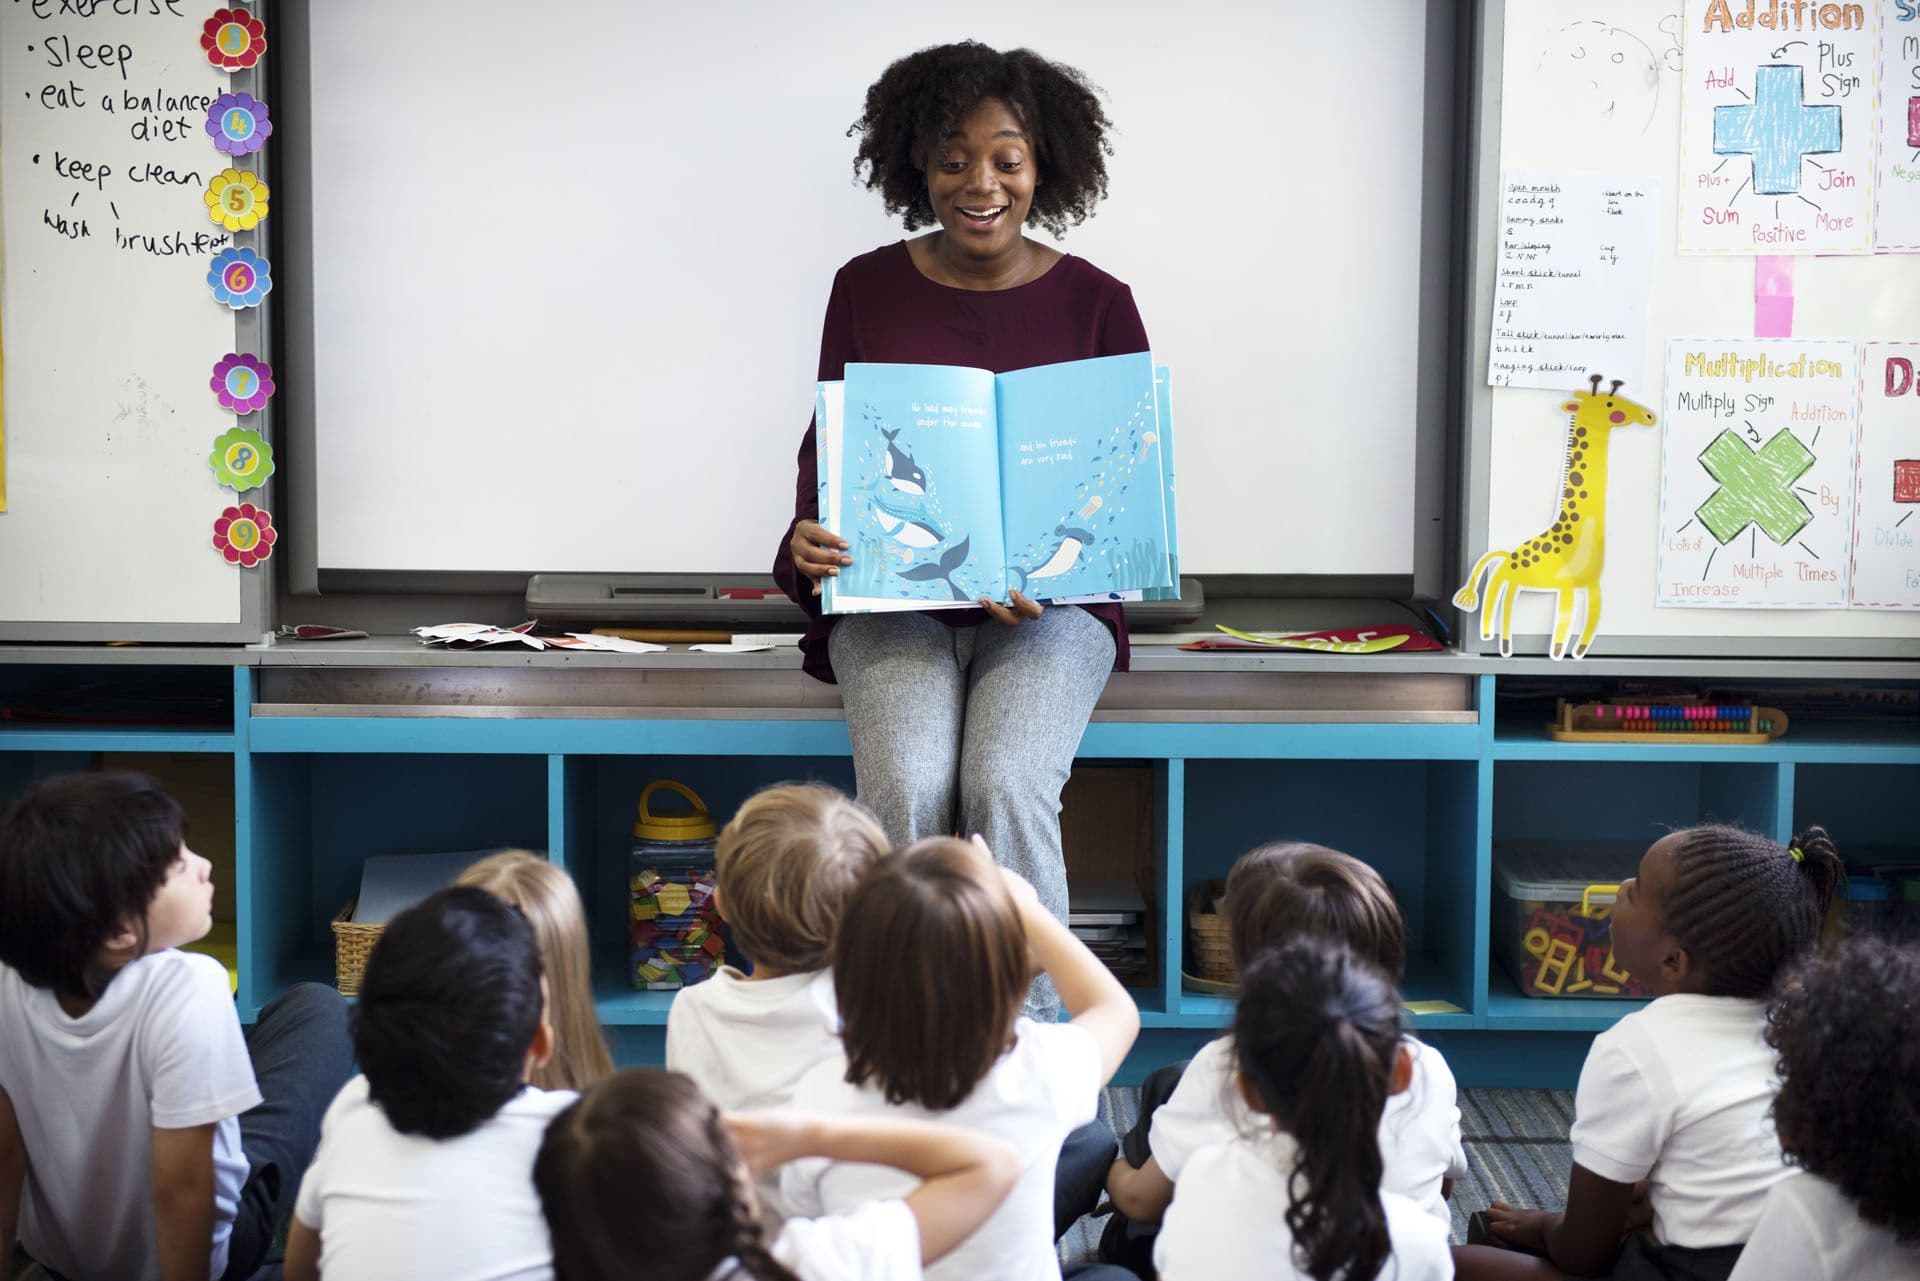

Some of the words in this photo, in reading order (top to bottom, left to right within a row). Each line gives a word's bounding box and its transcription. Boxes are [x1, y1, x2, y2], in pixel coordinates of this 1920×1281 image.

[1703, 0, 1864, 33] Addition
[224, 27, 241, 51] 3
[1818, 40, 1855, 73] Plus
[1704, 67, 1734, 90] Add
[1822, 74, 1860, 98] Sign
[41, 81, 85, 109] eat
[102, 95, 115, 114] a
[131, 116, 192, 142] diet
[229, 112, 247, 134] 4
[128, 163, 201, 186] clean
[1818, 168, 1856, 191] Join
[228, 189, 244, 211] 5
[1703, 206, 1740, 225] Sum
[1816, 212, 1853, 232] More
[1752, 223, 1807, 244] Positive
[230, 266, 246, 290] 6
[1685, 352, 1842, 383] Multiplication
[235, 373, 248, 394] 7
[1678, 391, 1735, 418] Multiply
[1744, 393, 1775, 412] Sign
[1791, 402, 1847, 422] Addition
[232, 446, 252, 471] 8
[1820, 486, 1840, 516] By
[237, 523, 252, 547] 9
[1875, 527, 1913, 548] Divide
[1733, 562, 1784, 589] Multiple
[1794, 561, 1838, 582] Times
[1671, 582, 1741, 597] Increase
